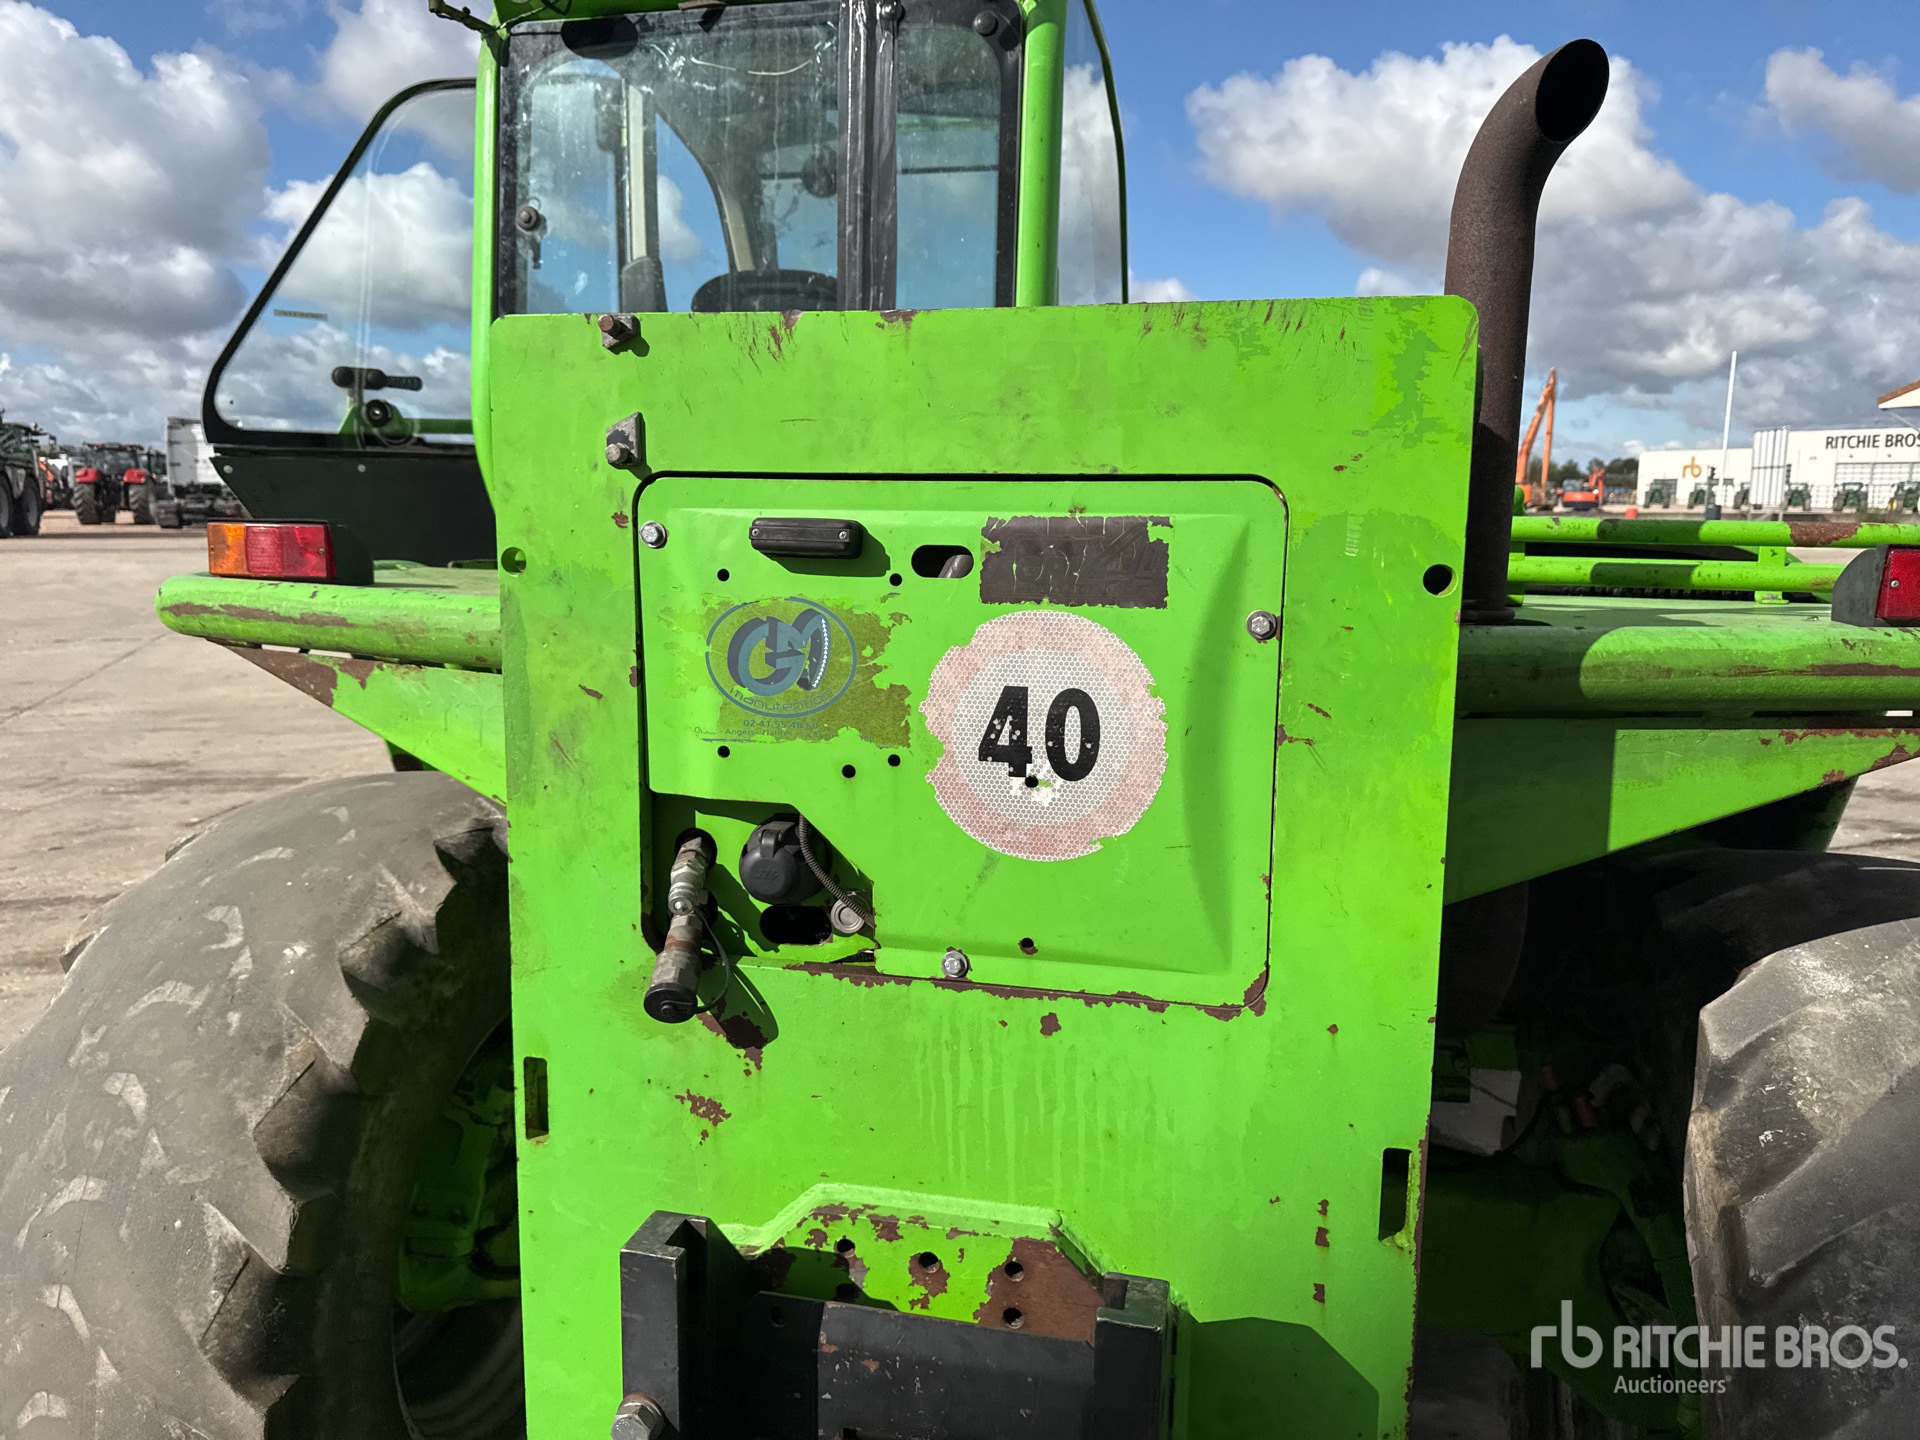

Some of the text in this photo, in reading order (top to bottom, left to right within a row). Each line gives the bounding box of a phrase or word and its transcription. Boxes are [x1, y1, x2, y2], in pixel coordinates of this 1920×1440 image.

[1825, 434, 1881, 450] RITCHIE
[1682, 456, 1702, 478] rb
[730, 687, 833, 711] manutention
[725, 728, 755, 737] Angers
[978, 685, 1101, 782] 40
